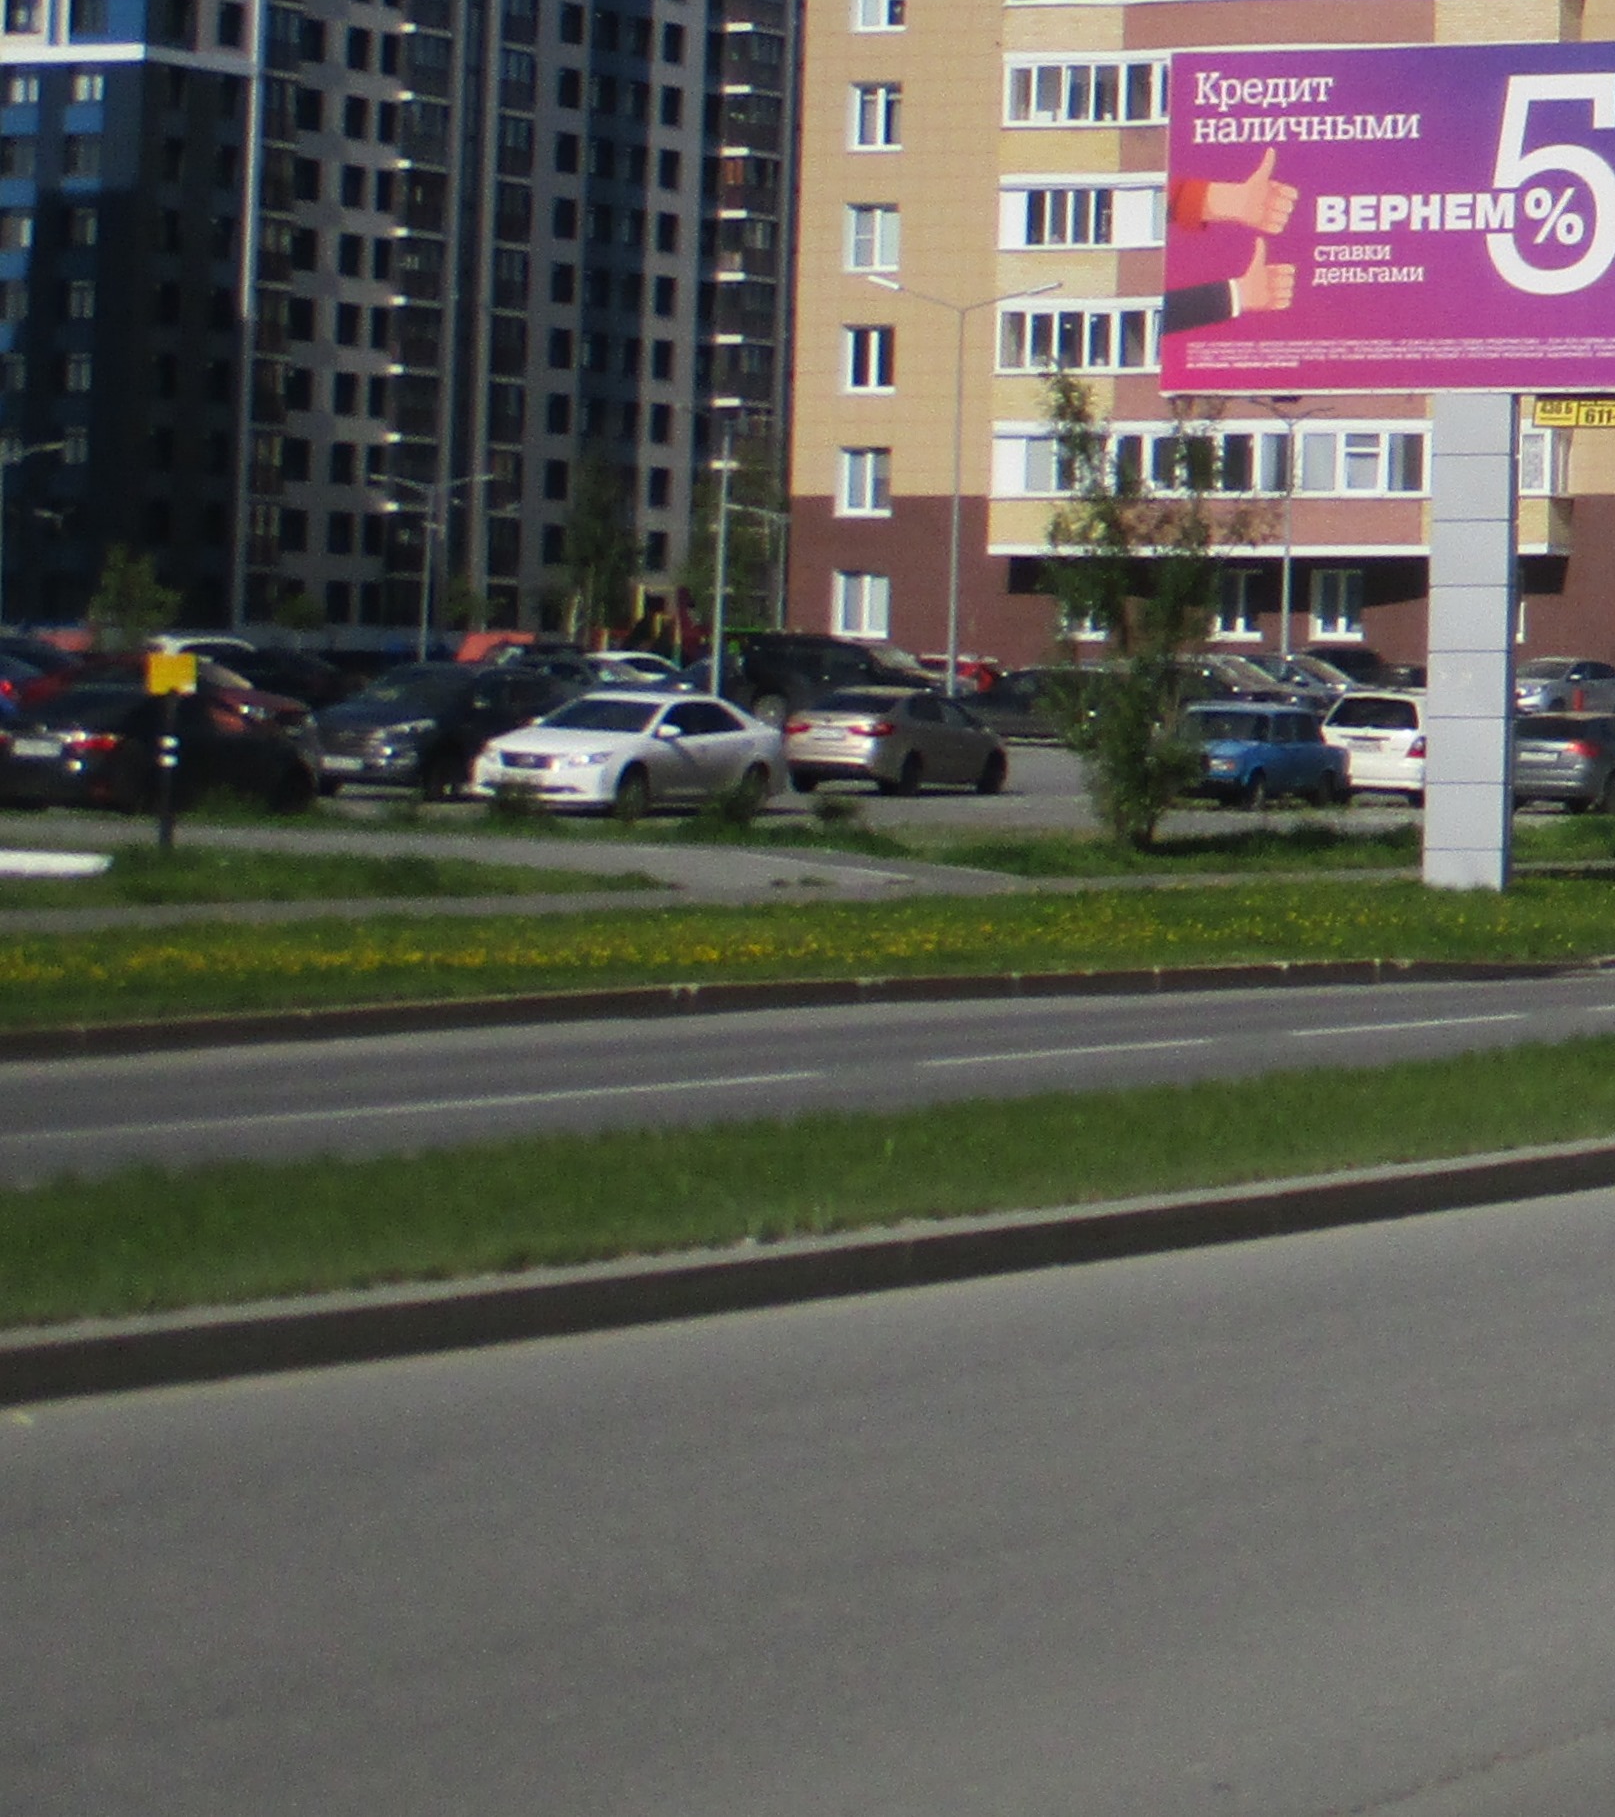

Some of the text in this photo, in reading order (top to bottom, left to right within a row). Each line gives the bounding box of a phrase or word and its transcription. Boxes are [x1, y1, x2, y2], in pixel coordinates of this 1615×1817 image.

[1194, 72, 1334, 112] Кредит
[1193, 113, 1421, 143] наличными
[1315, 193, 1516, 232] ВЕРНЕМ
[1314, 245, 1391, 262] ставки
[1312, 266, 1425, 287] деньгами
